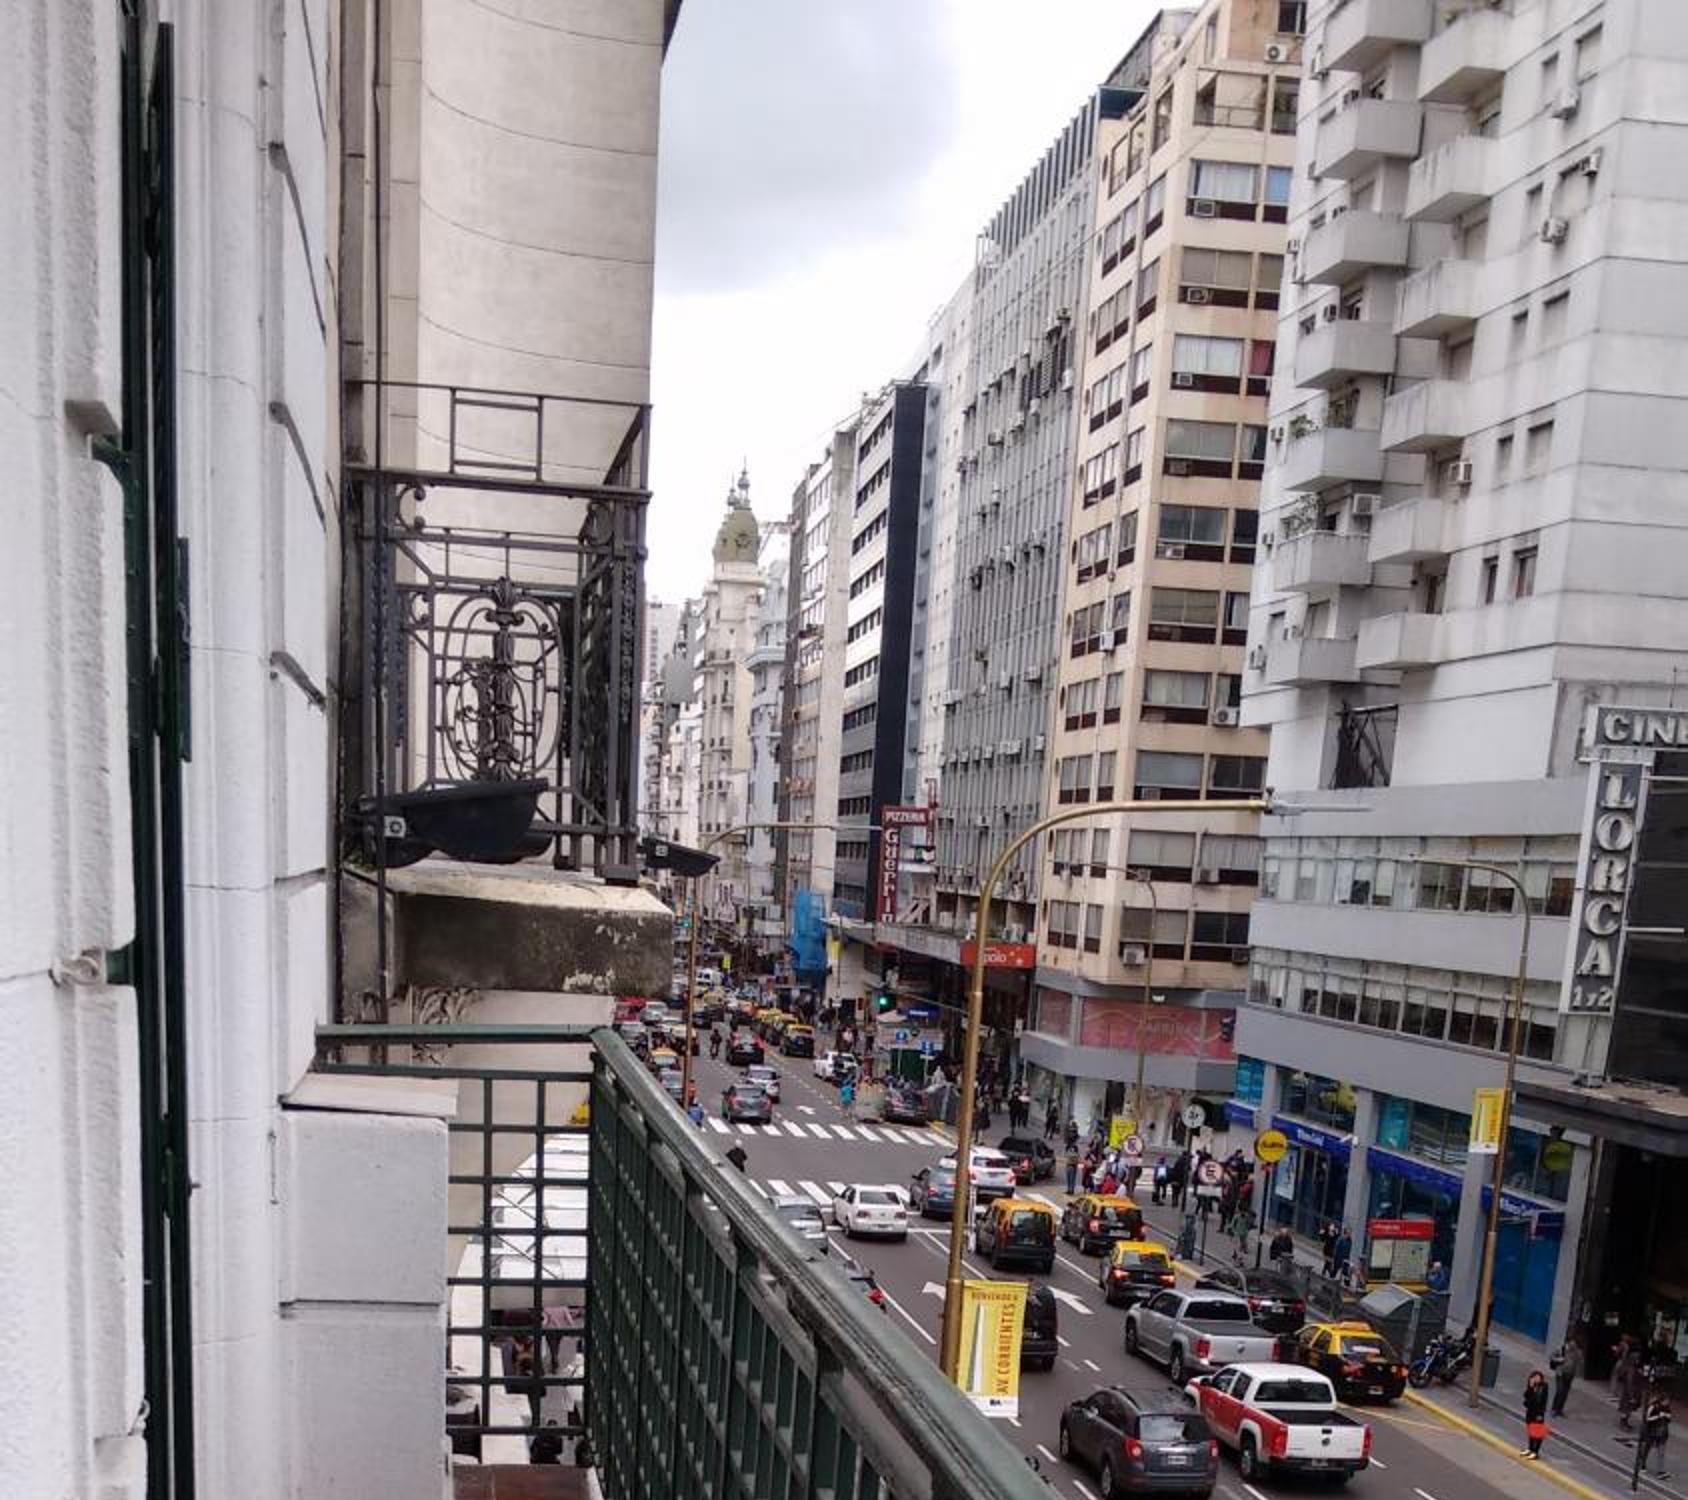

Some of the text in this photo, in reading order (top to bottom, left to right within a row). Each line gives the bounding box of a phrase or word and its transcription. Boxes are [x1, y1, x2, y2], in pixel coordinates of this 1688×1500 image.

[1576, 769, 1637, 975] LORCA
[982, 950, 1007, 964] polo
[997, 1303, 1016, 1375] CORRIENTES
